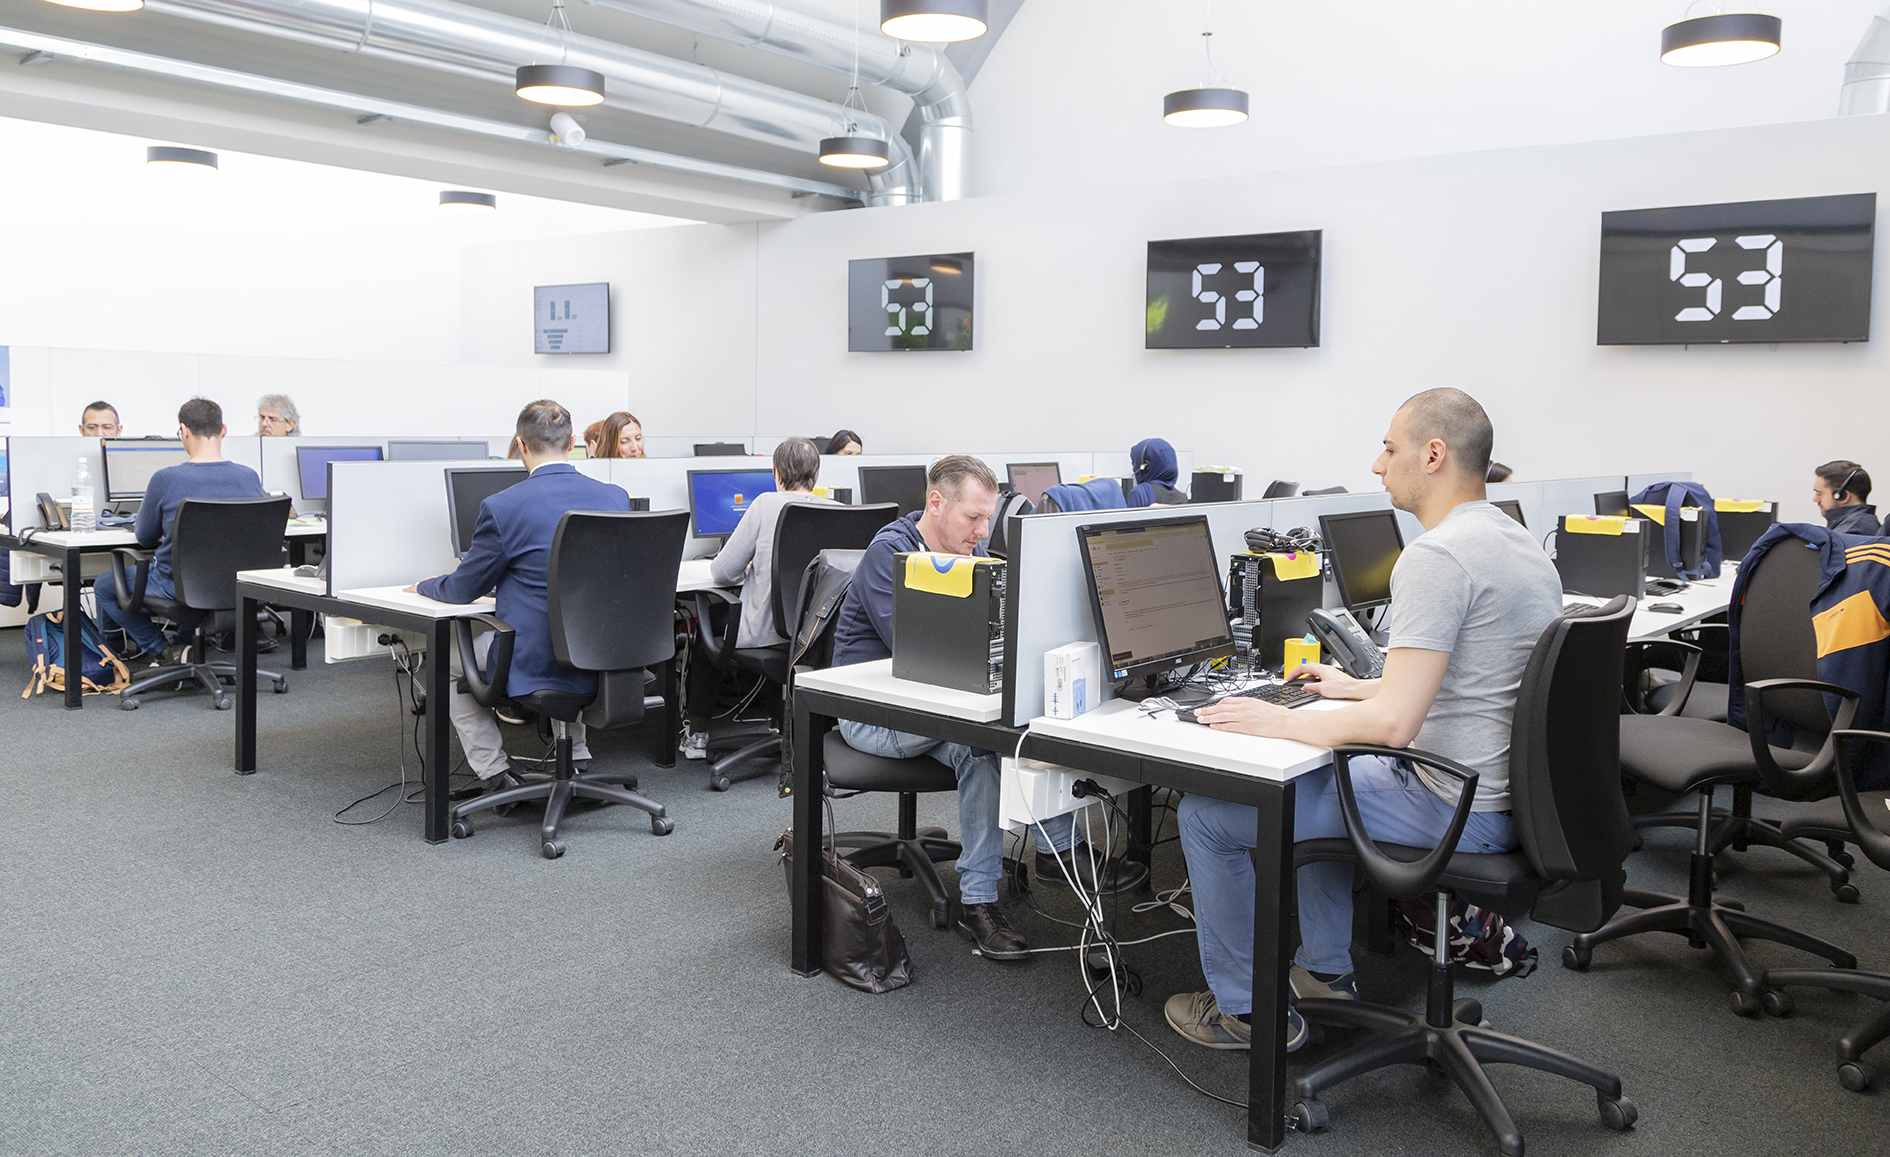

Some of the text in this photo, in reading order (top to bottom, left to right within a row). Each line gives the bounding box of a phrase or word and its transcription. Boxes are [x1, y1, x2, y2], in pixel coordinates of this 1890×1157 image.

[881, 277, 934, 336] 53
[1192, 261, 1265, 331] 53
[1670, 234, 1784, 321] 53
